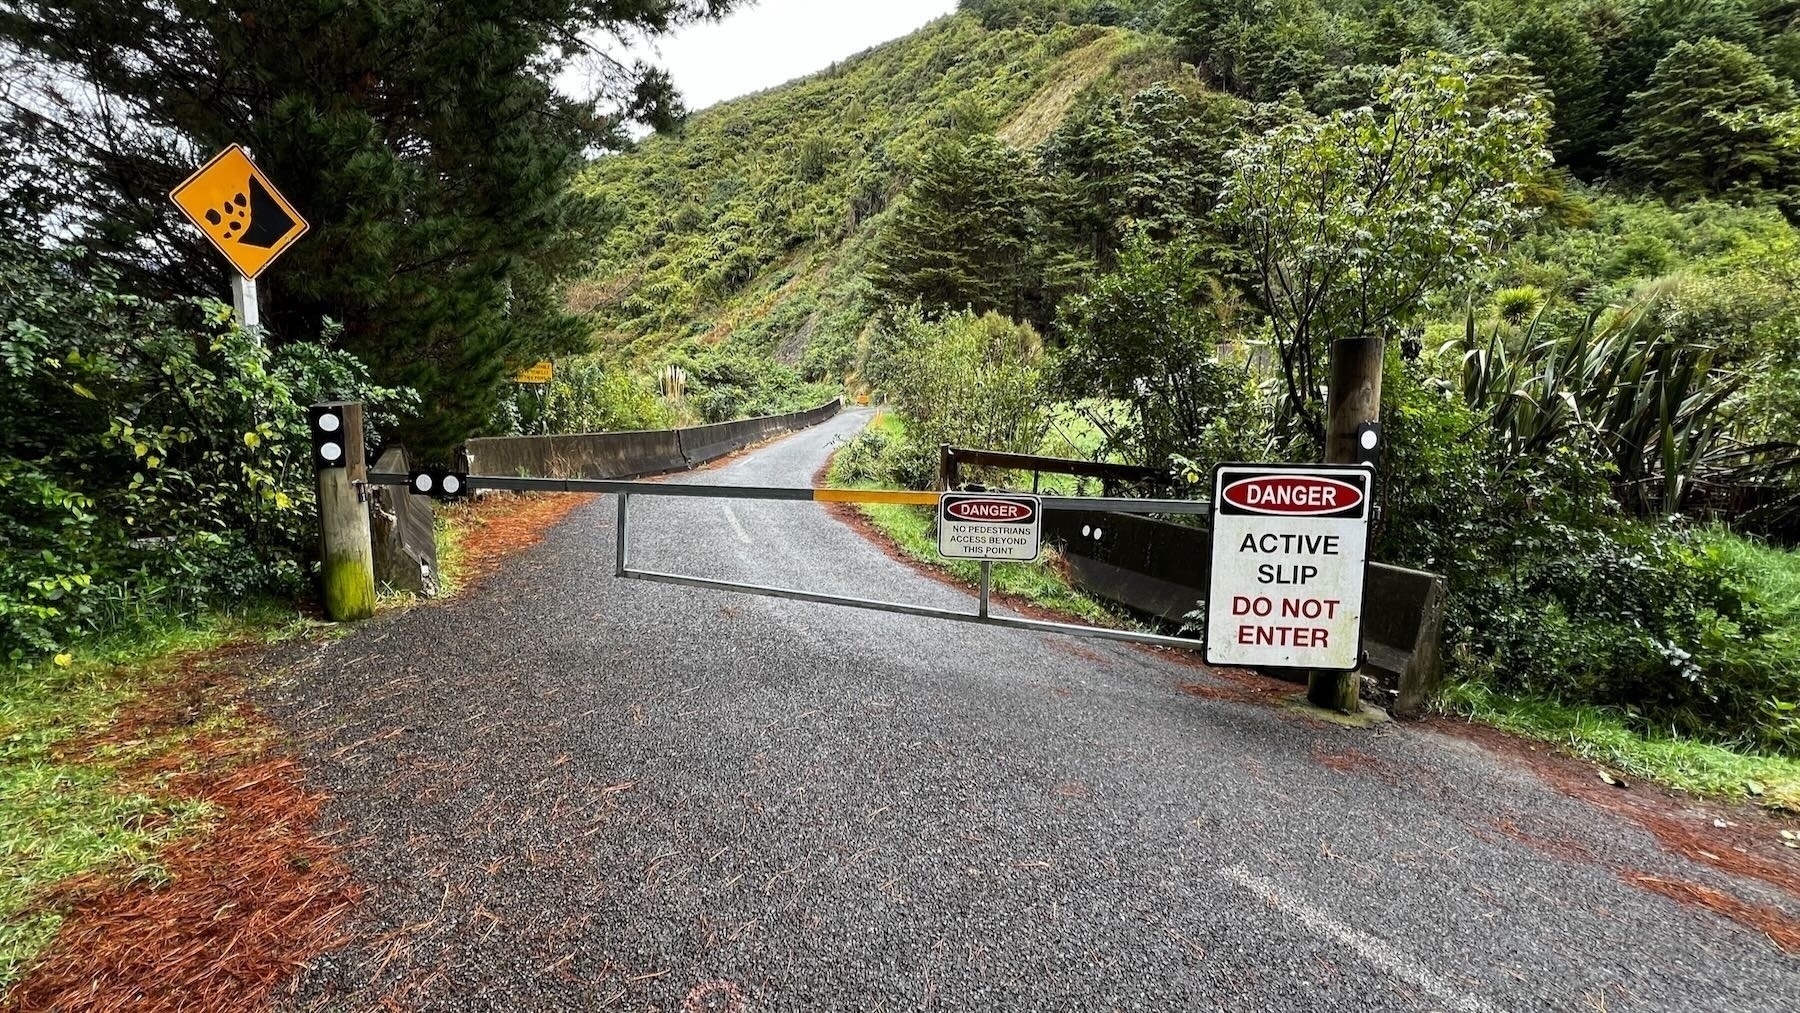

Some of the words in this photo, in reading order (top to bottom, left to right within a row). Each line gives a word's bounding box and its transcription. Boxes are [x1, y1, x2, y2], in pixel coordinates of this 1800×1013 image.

[1247, 485, 1337, 506] DANGER
[961, 504, 1018, 517] DANGER
[950, 535, 986, 544] ACCESS
[989, 537, 1027, 545] BEYOND
[952, 525, 966, 533] NO
[968, 526, 1031, 535] PEDESTRIANS
[963, 546, 983, 554] THIS
[985, 547, 1014, 555] POINT
[1239, 533, 1340, 555] ACTIVE
[1257, 564, 1318, 585] SLIP
[1232, 596, 1272, 617] DO
[1281, 598, 1340, 620] NOT
[1238, 625, 1329, 648] ENTER
